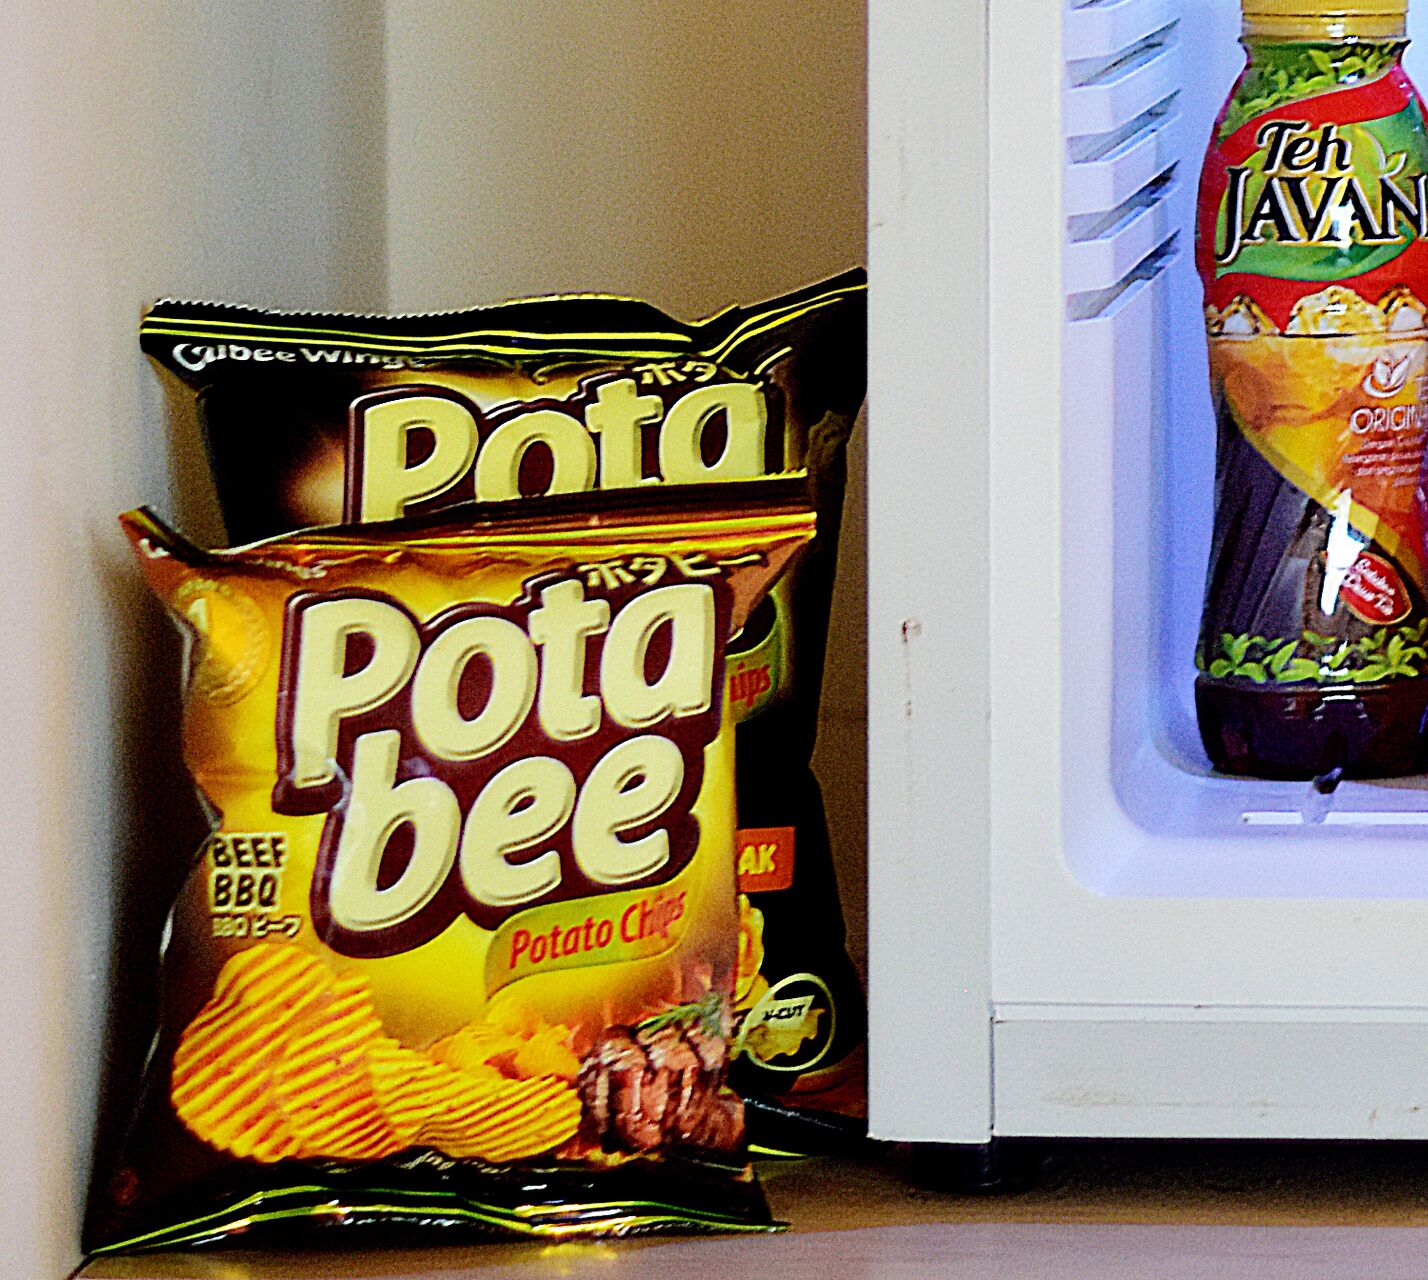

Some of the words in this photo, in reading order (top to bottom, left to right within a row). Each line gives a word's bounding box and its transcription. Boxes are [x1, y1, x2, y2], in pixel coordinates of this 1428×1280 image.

[1257, 121, 1351, 175] Teh
[171, 343, 297, 372] Calbee
[360, 377, 769, 523] Pota
[292, 579, 716, 789] Pota
[212, 835, 286, 869] BEEF
[328, 729, 686, 932] bee
[213, 873, 279, 908] BBQ
[508, 915, 614, 971] Potato
[619, 890, 687, 944] Chips
